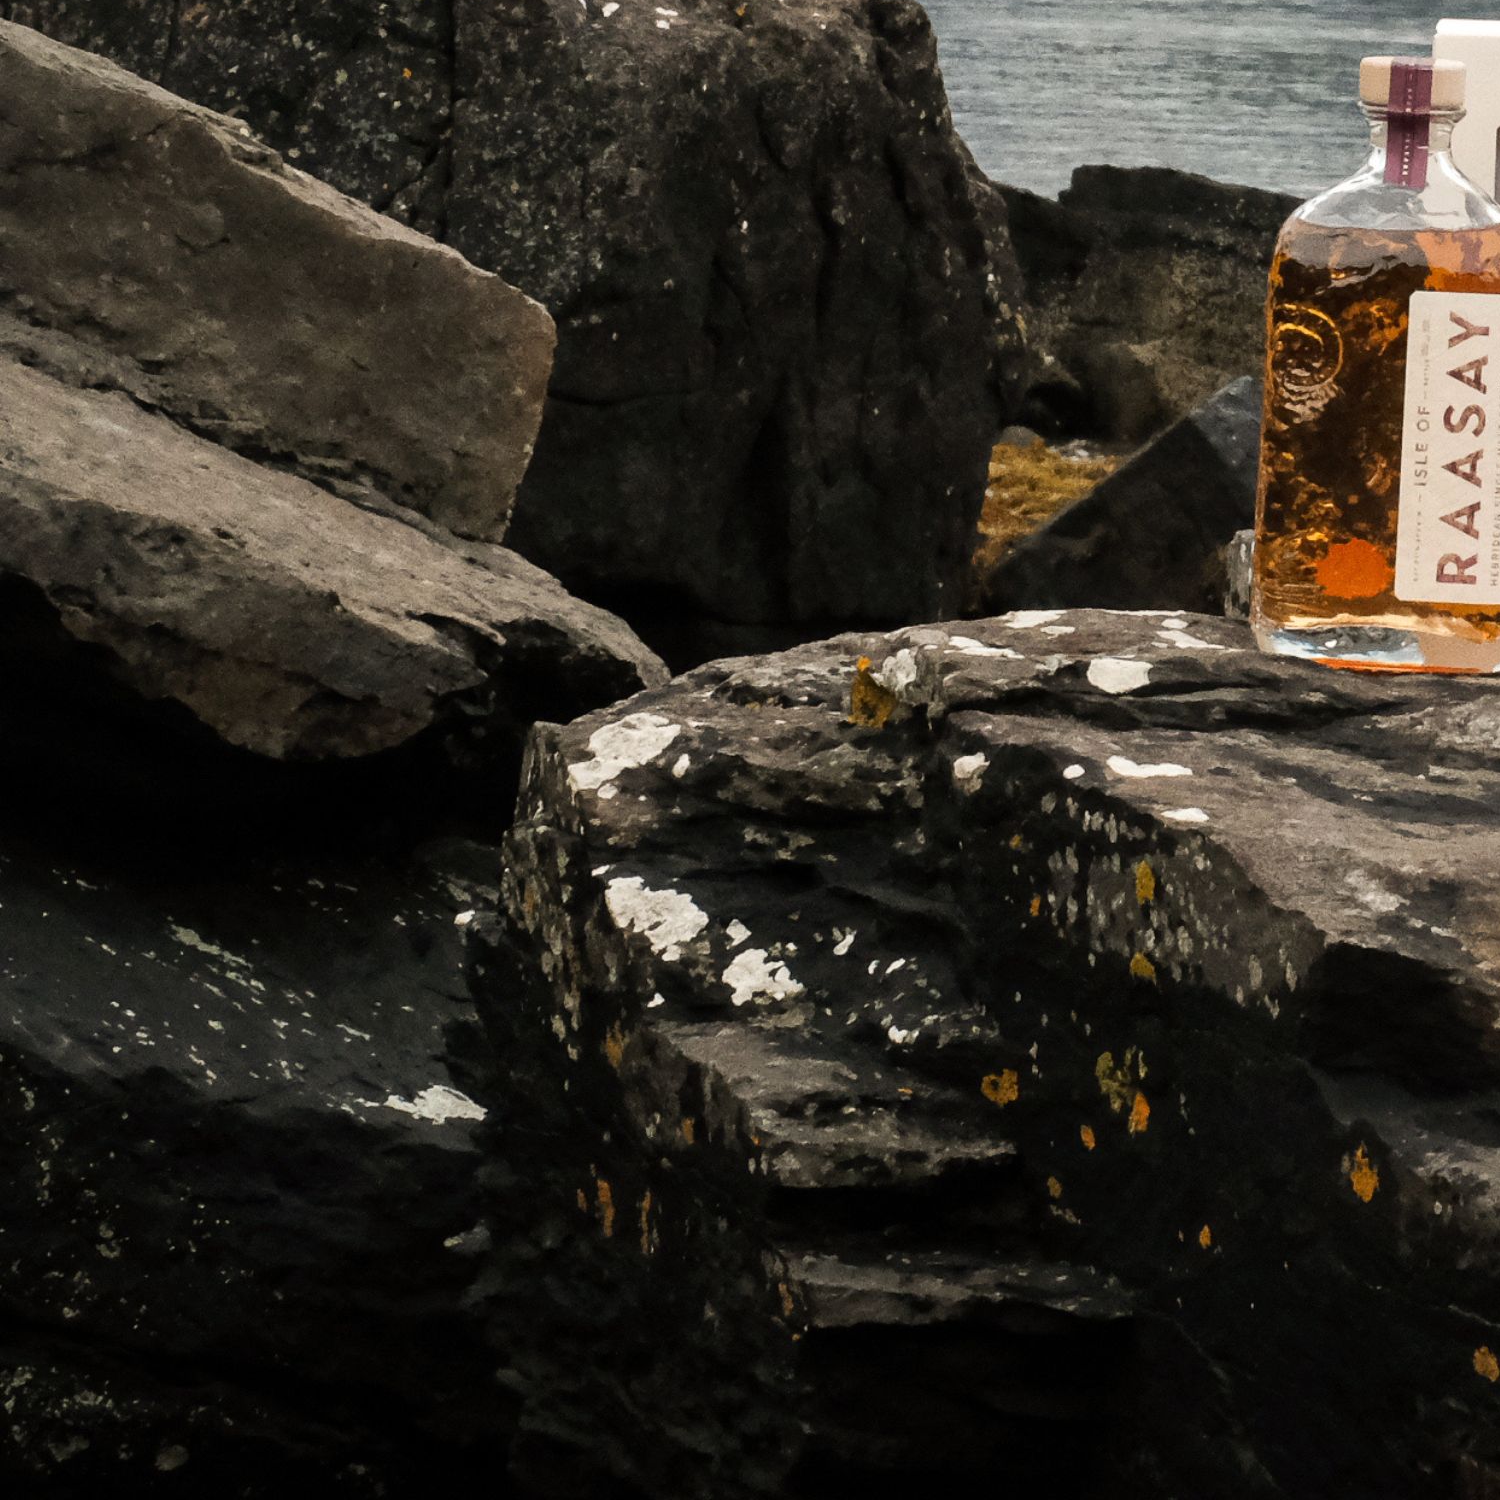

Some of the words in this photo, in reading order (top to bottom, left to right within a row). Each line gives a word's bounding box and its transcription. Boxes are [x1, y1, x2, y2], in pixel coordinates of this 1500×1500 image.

[1416, 405, 1431, 433] OF
[1414, 443, 1430, 487] ISLE
[1435, 311, 1490, 585] RAASAY
